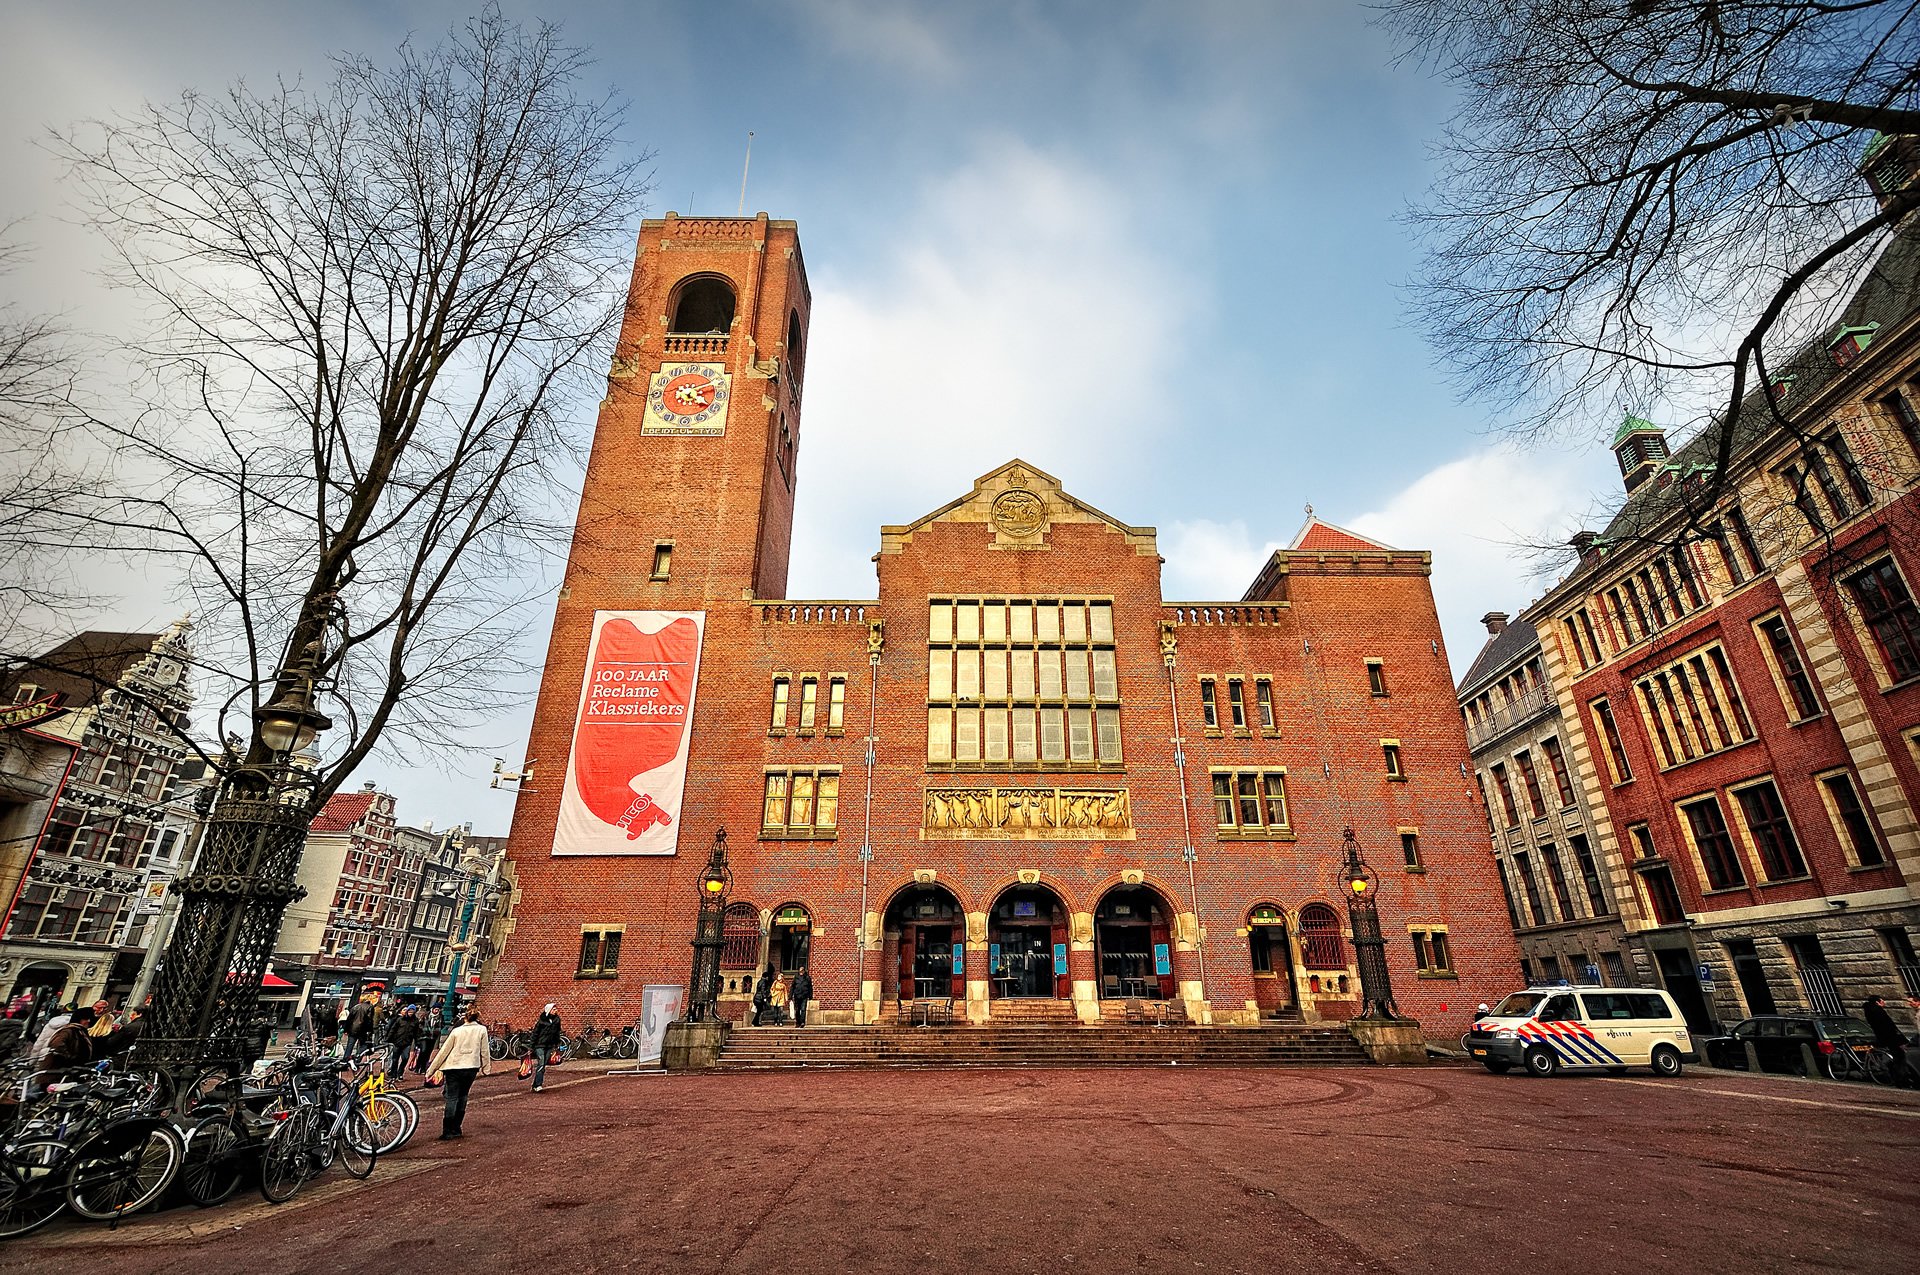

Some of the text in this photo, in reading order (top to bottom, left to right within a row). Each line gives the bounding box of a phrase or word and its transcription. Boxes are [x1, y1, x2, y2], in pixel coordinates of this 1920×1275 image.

[595, 669, 669, 682] 100 JAAR
[591, 684, 660, 698] Reclame
[587, 700, 685, 715] Klassiekers
[1699, 966, 1708, 979] P
